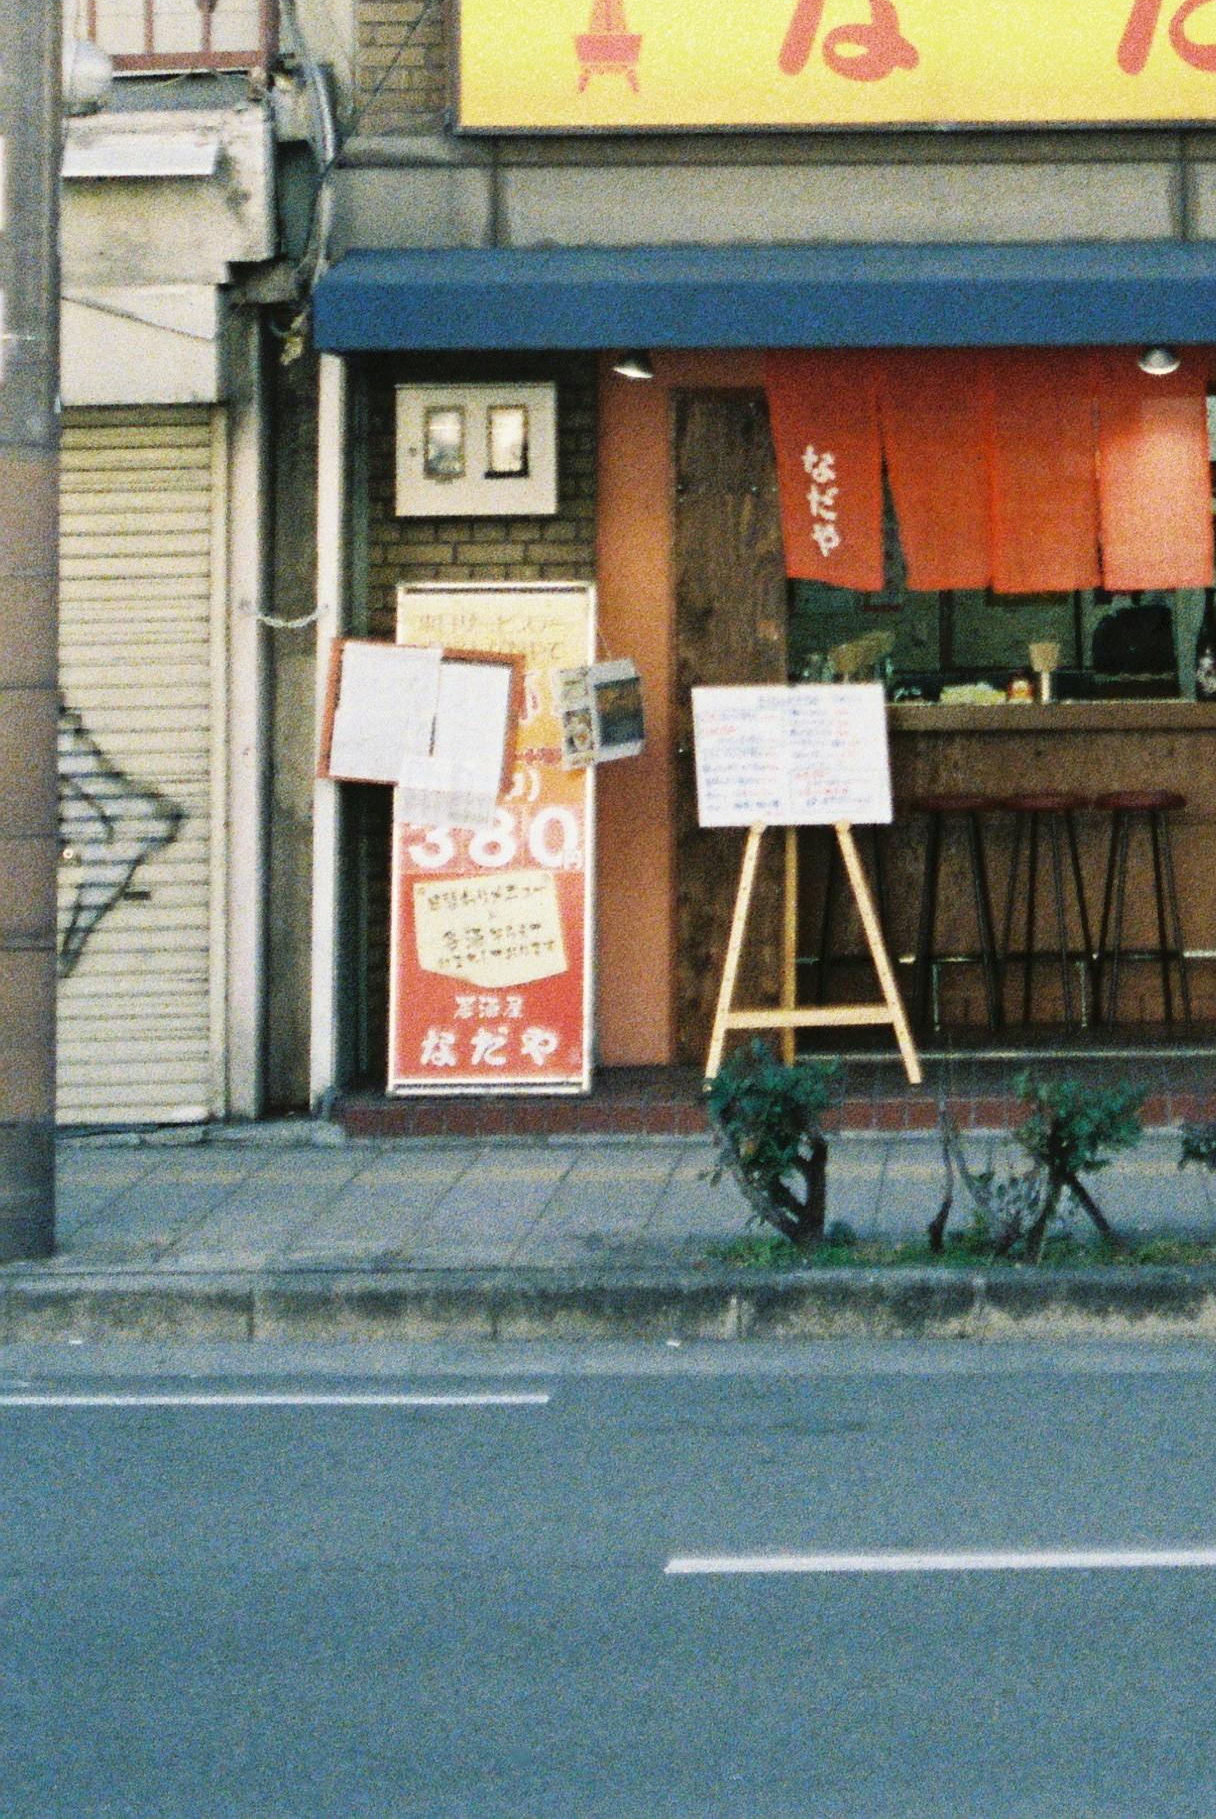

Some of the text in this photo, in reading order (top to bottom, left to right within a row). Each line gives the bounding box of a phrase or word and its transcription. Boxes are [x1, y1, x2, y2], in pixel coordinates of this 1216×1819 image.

[801, 444, 841, 557] なだや
[420, 1026, 559, 1067] なだや
